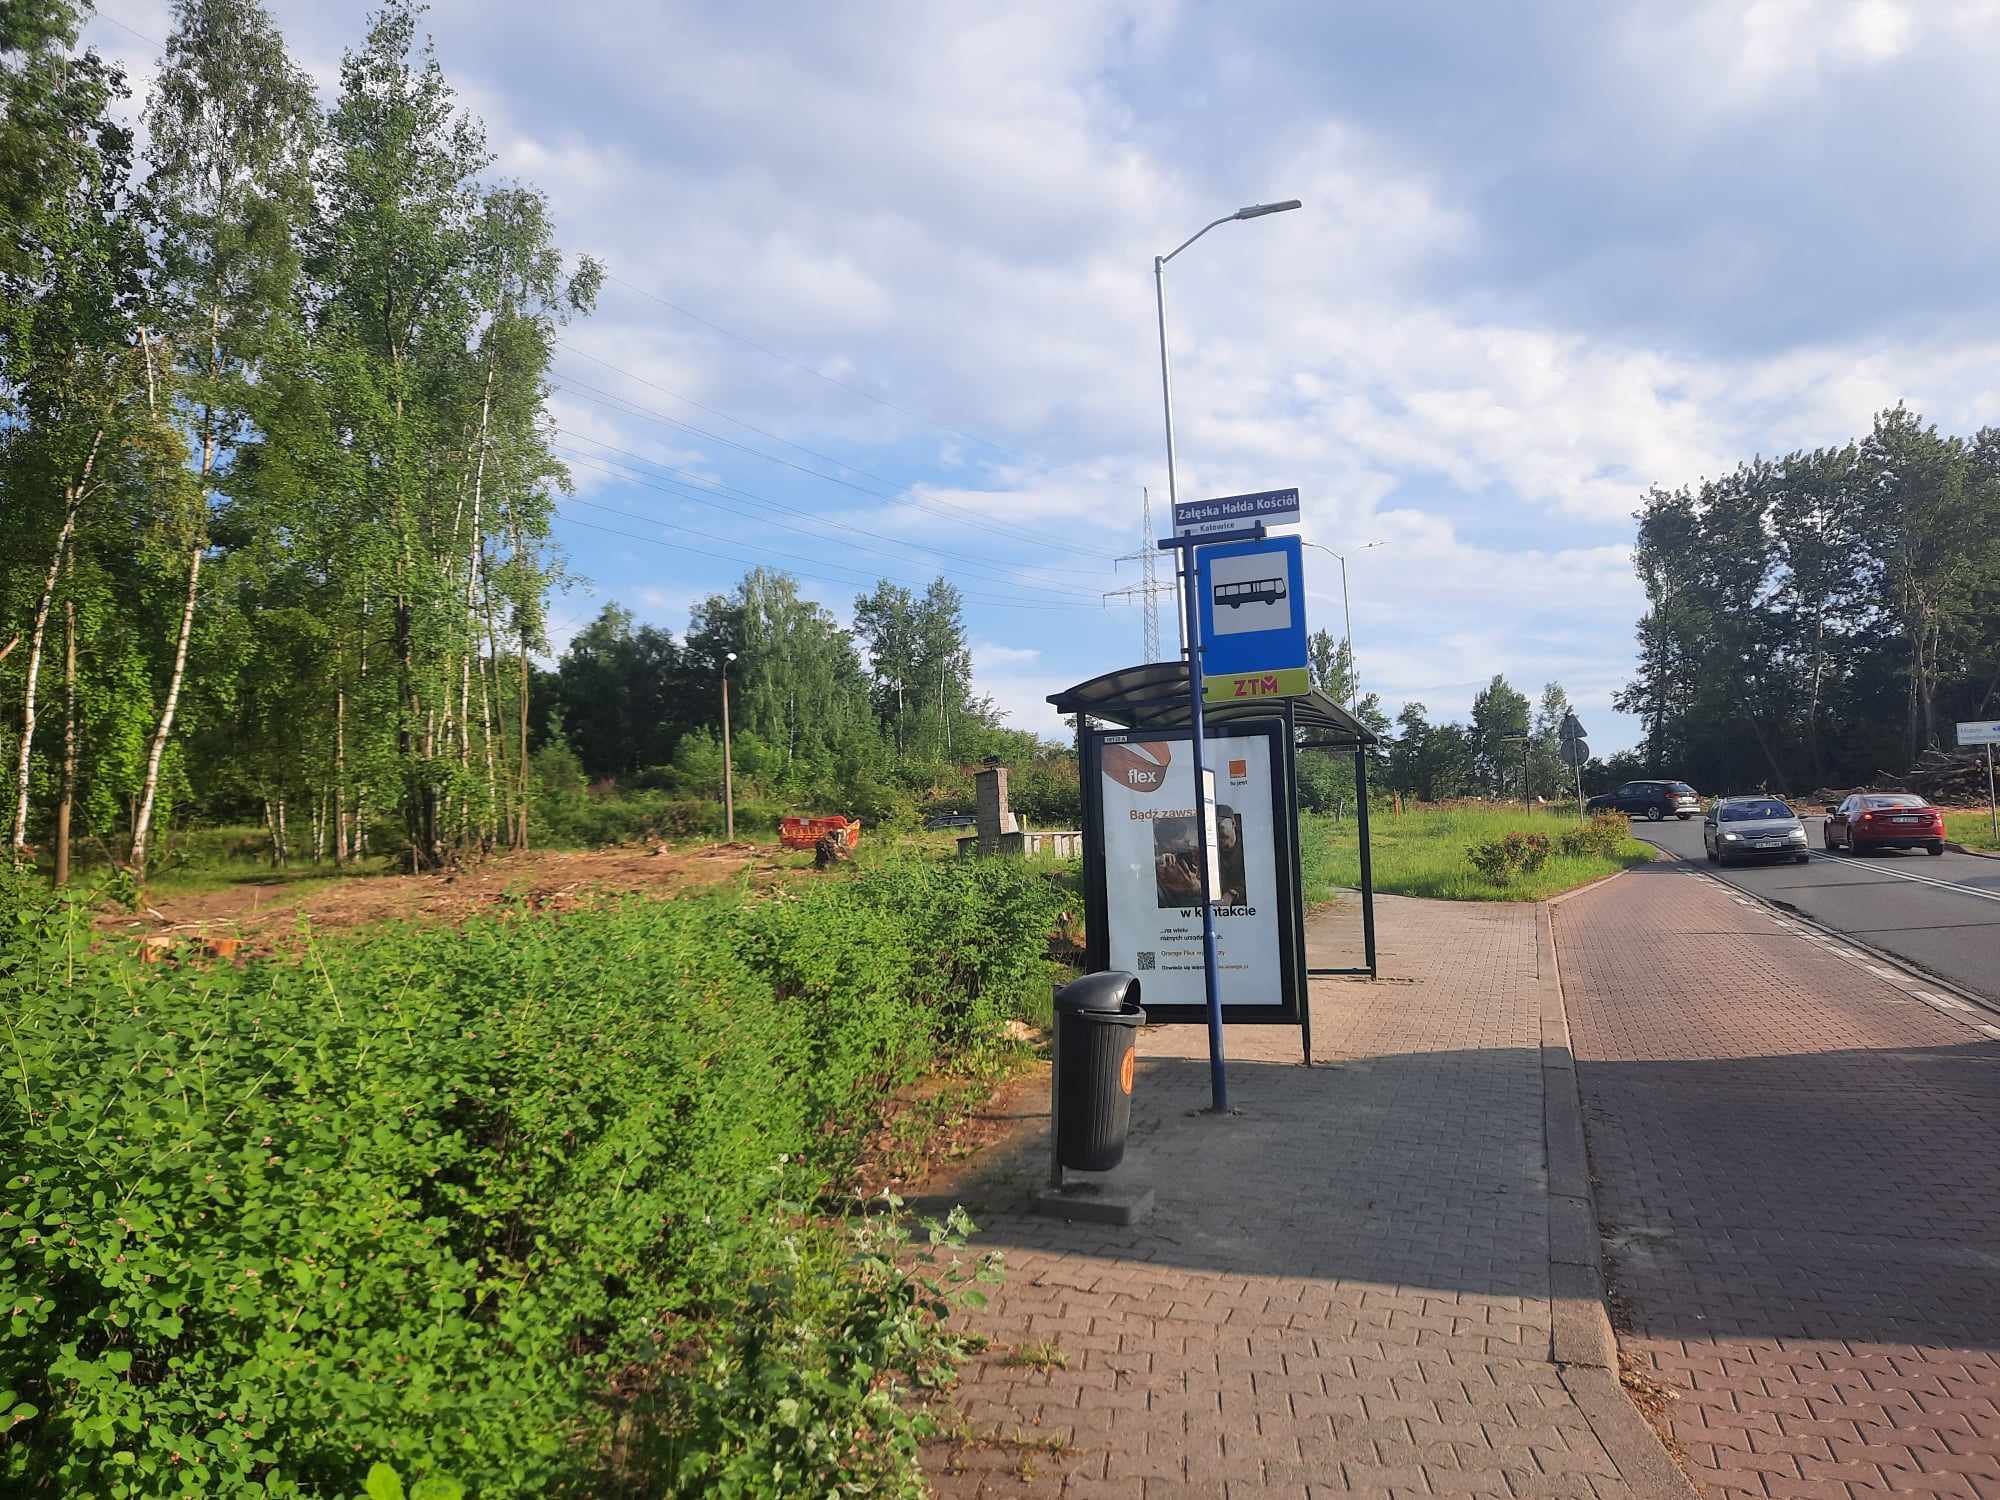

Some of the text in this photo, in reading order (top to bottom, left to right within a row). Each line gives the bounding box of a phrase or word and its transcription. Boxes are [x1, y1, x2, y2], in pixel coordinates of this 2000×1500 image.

[1178, 493, 1297, 520] Załęska Hałda Kościół
[1200, 522, 1235, 533] Katowice
[1233, 676, 1278, 696] ZTM
[1128, 768, 1157, 784] flex
[1180, 905, 1256, 918] w kntakcie
